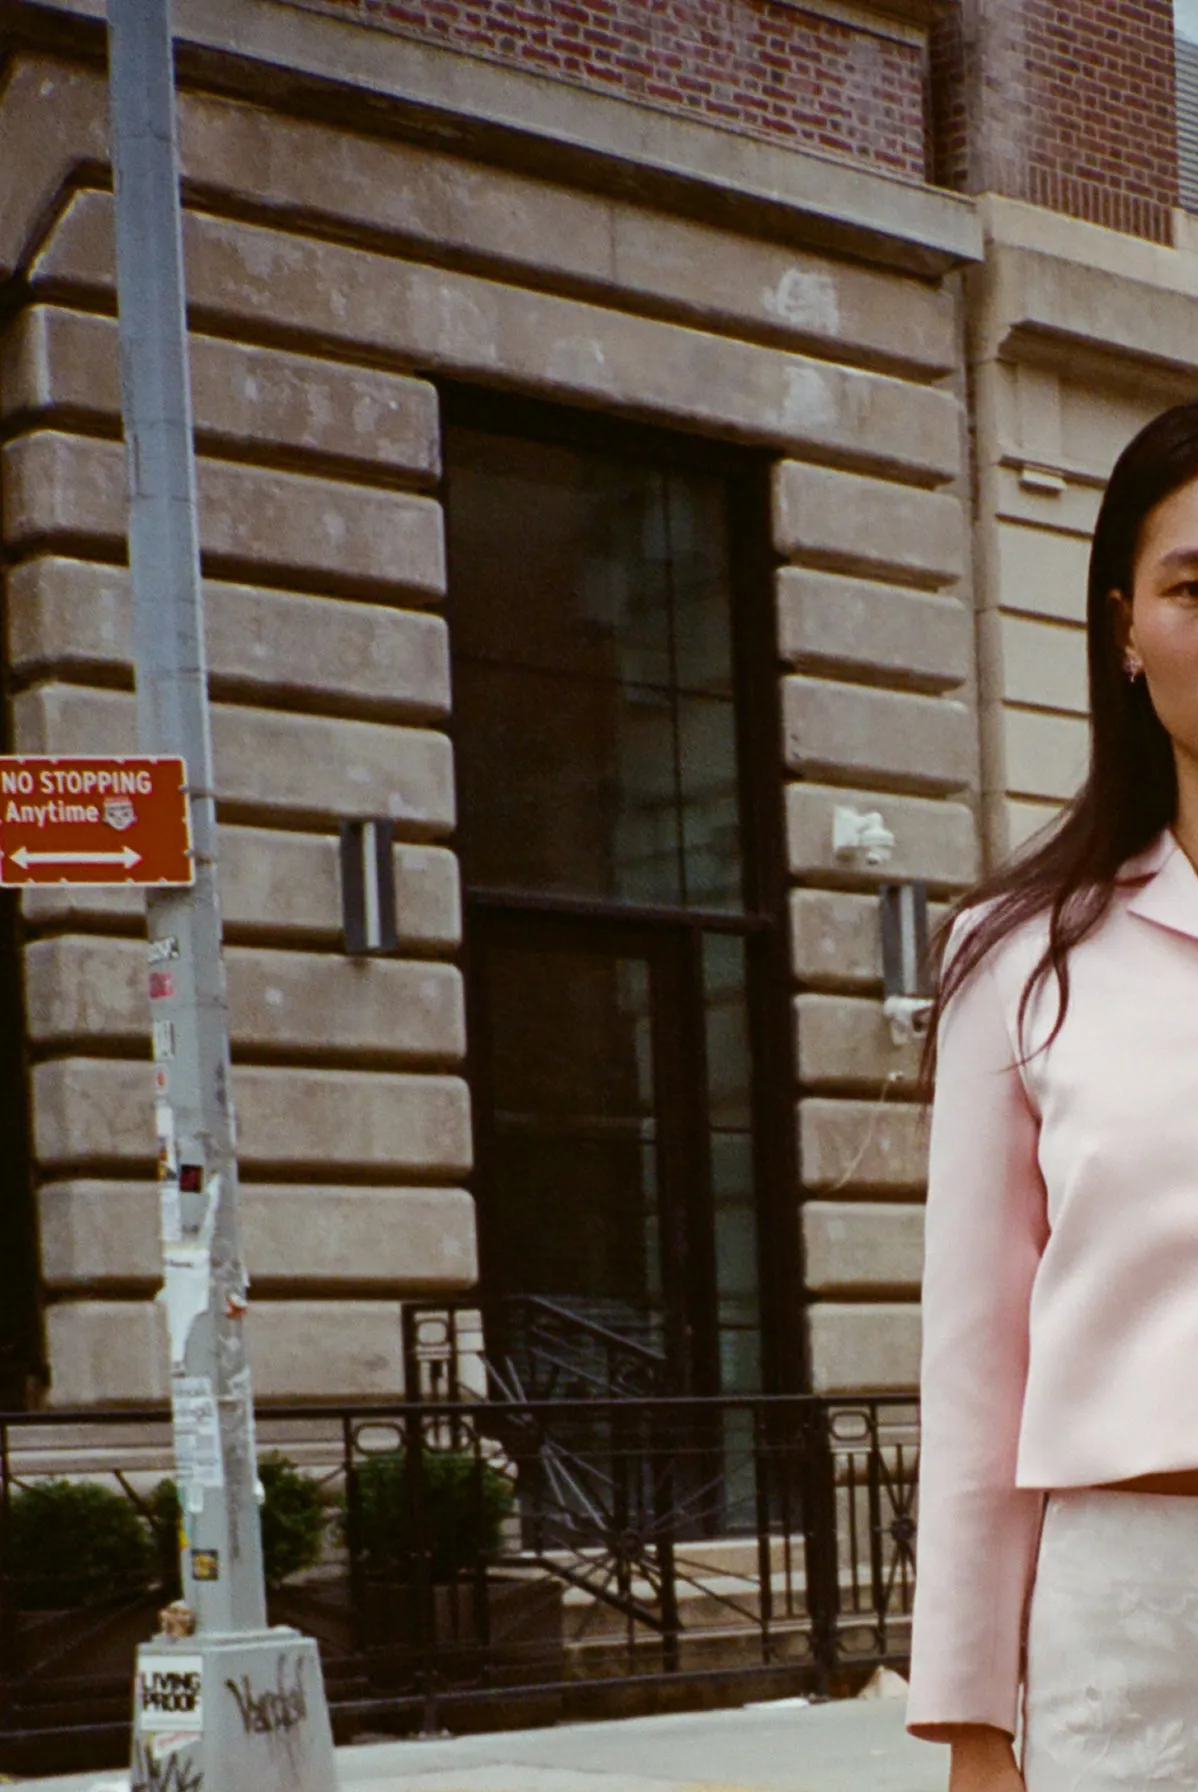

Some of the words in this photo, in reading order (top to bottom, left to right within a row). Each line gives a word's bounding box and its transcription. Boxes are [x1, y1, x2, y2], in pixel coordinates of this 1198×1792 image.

[1, 771, 34, 794] NO
[40, 771, 152, 794] STOPPING
[6, 800, 99, 828] Anytime
[141, 1671, 201, 1693] LIVING
[143, 1691, 199, 1712] PROOF
